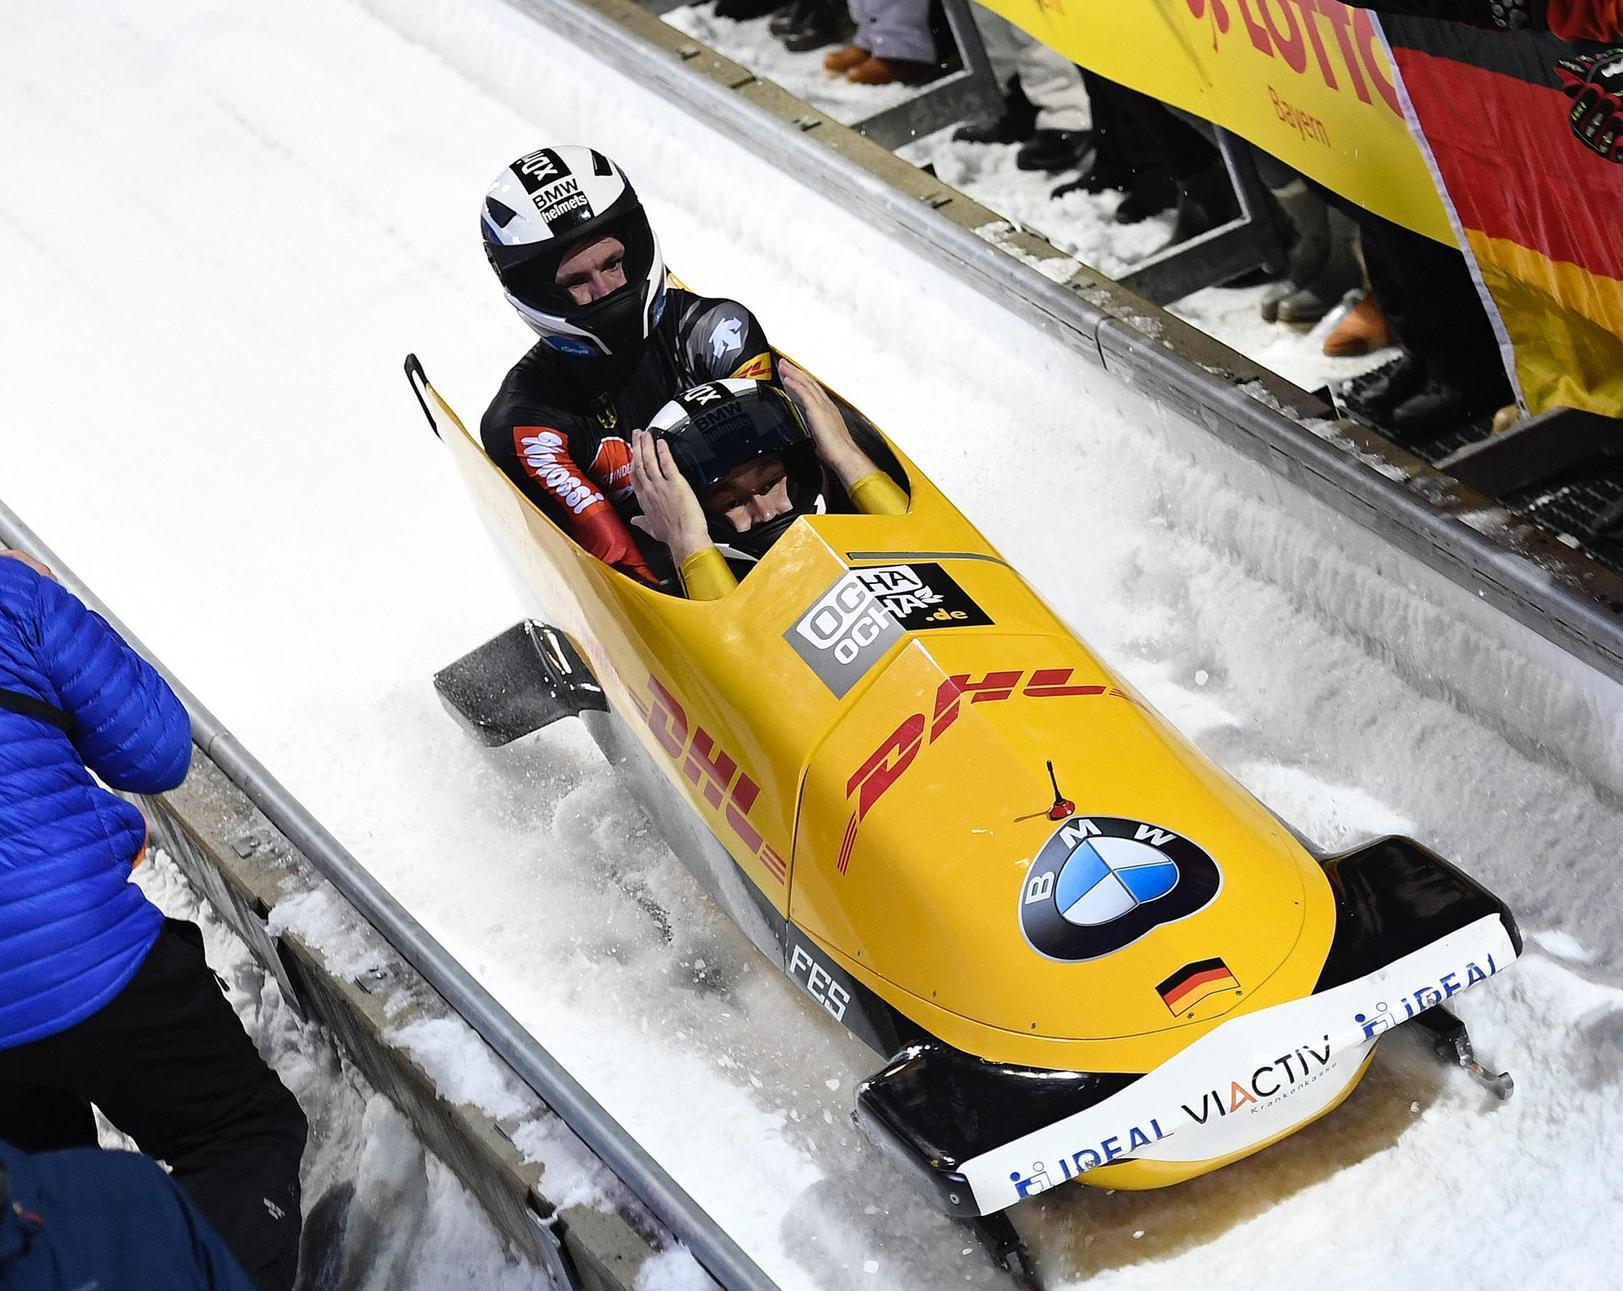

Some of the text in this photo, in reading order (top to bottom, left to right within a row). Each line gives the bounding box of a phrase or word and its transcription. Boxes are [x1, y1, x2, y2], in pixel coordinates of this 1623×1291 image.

[1267, 85, 1331, 147] Bayern
[532, 178, 578, 210] BMW
[541, 194, 588, 223] helmets
[695, 402, 742, 430] BMW
[810, 571, 919, 640] OCHA
[834, 595, 928, 664] OCHA
[926, 608, 968, 622] .de
[647, 673, 763, 856] DHL
[846, 668, 1106, 824] DHL
[1025, 819, 1177, 904] BMW
[790, 945, 850, 1023] FES
[1181, 1035, 1331, 1124] VIACTIV
[1250, 1062, 1337, 1115] Krankenkasse
